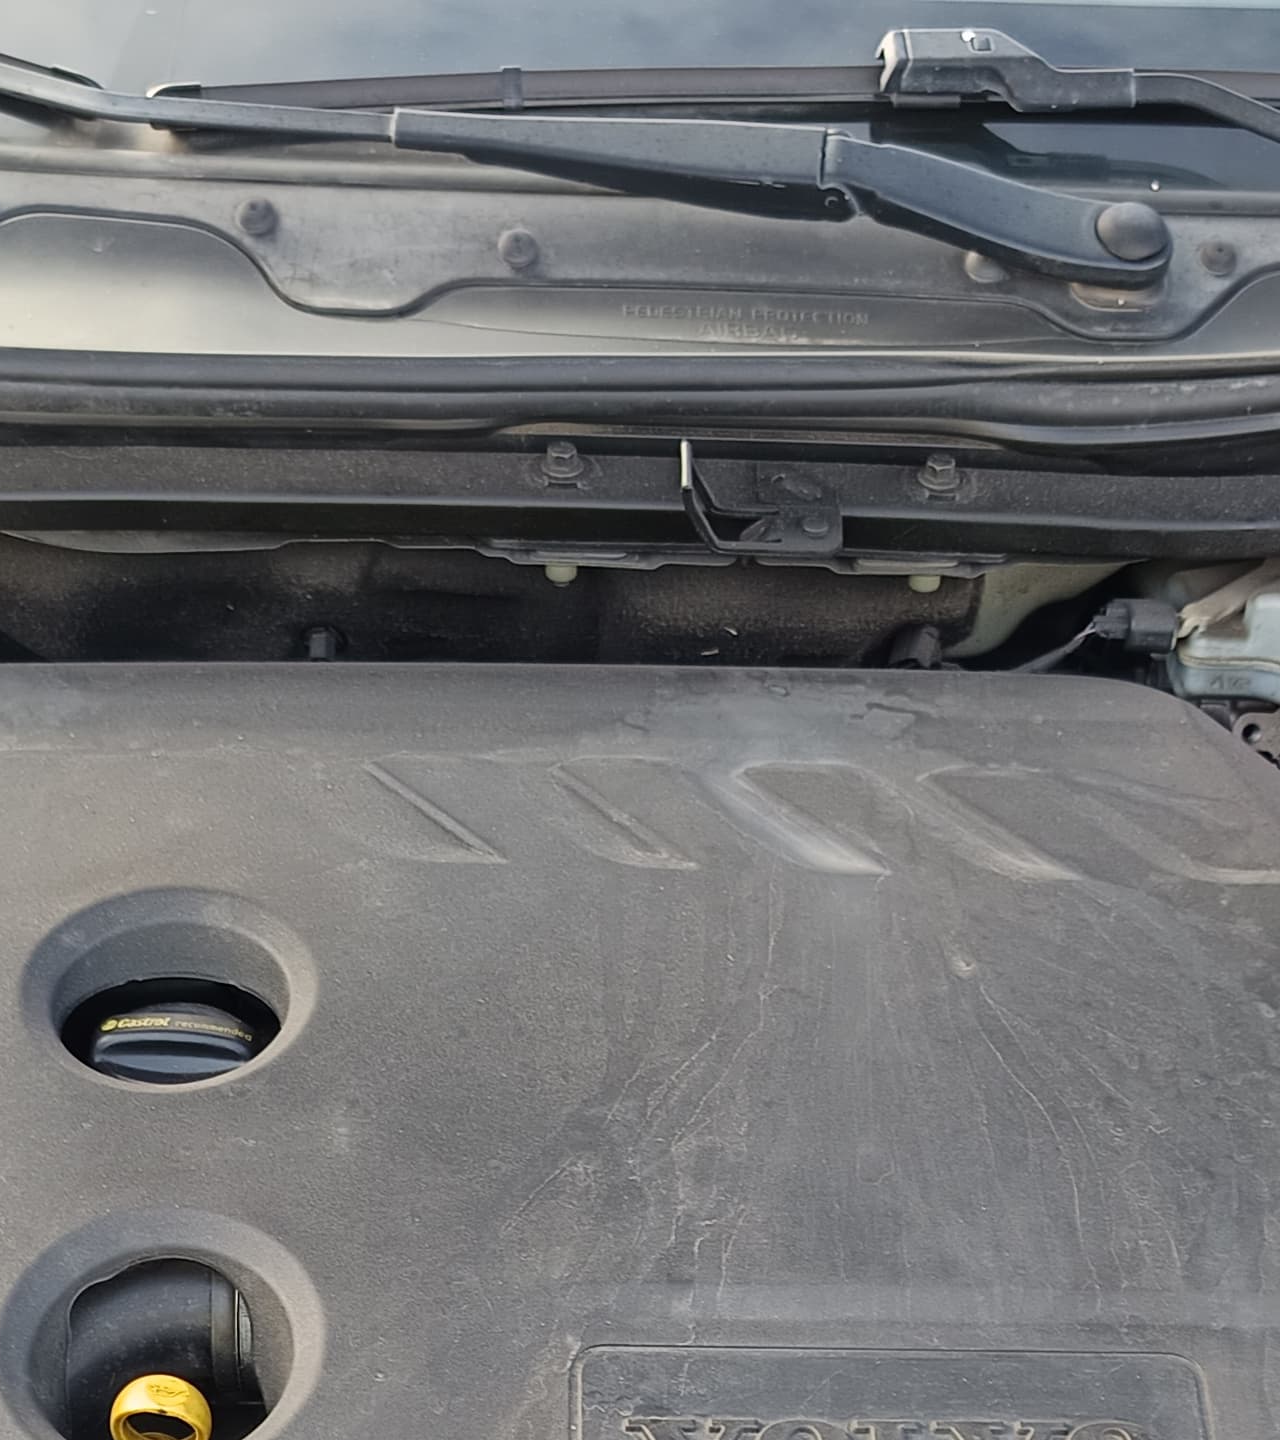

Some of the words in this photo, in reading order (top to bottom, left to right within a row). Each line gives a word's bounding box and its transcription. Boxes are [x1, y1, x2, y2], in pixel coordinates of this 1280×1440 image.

[622, 303, 742, 321] PEDESTRIAN
[751, 306, 870, 326] PROTECTION
[117, 1016, 171, 1029] Castrol
